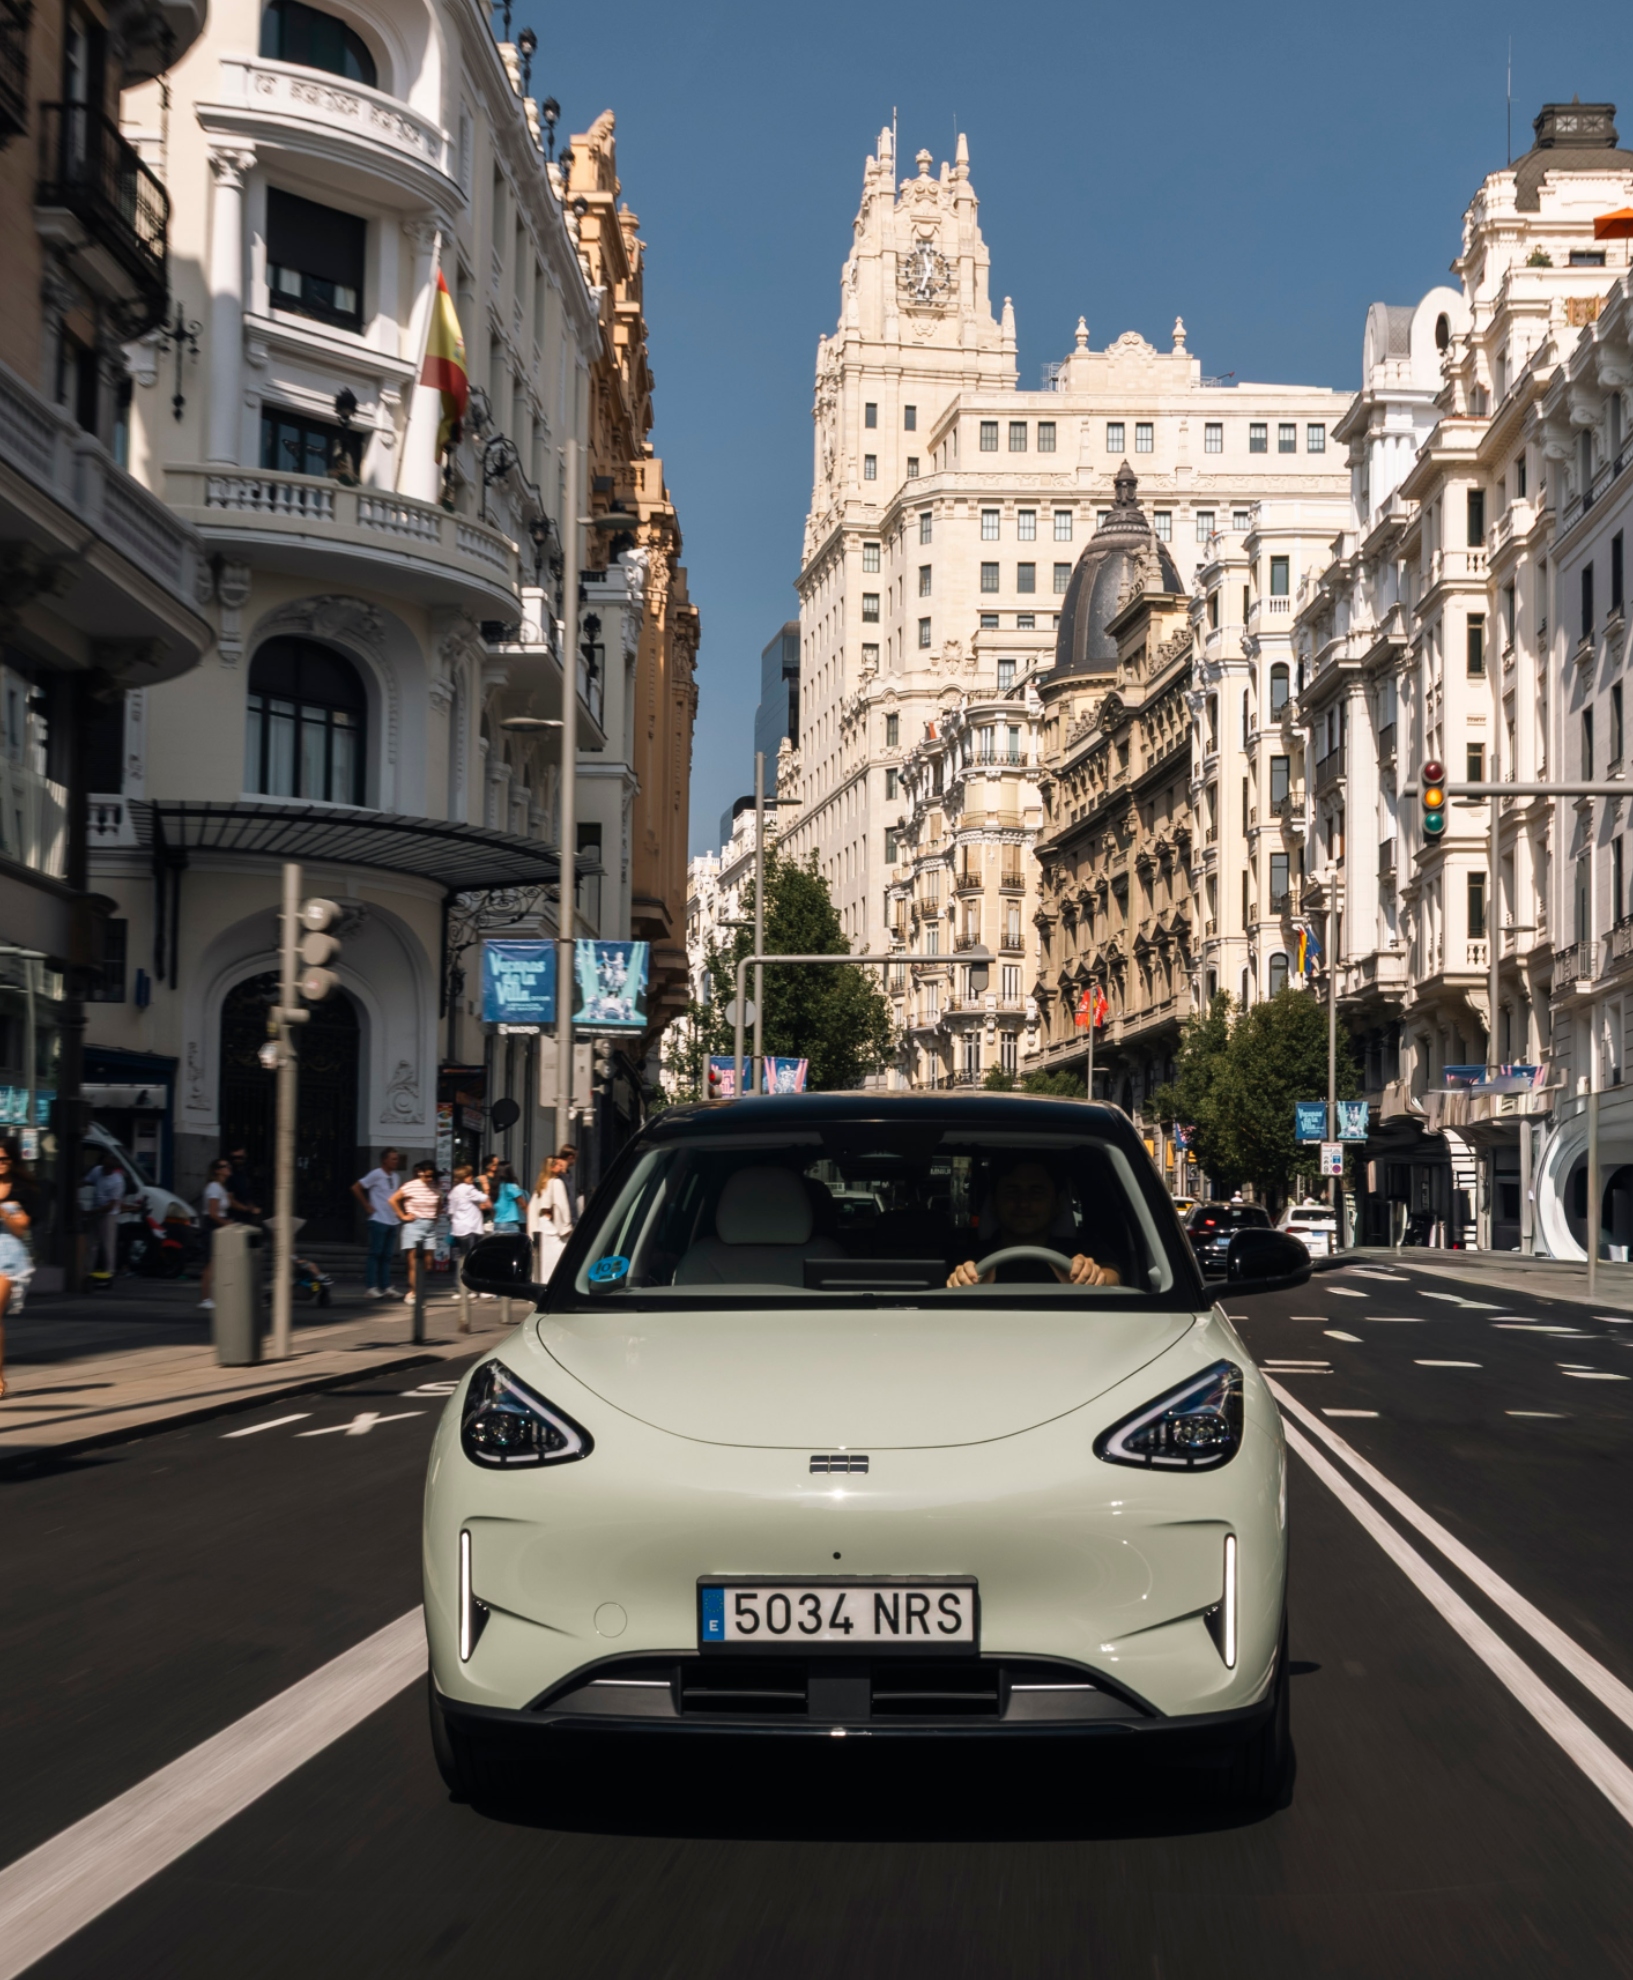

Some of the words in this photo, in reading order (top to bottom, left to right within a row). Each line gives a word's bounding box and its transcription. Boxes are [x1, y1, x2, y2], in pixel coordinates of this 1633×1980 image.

[495, 982, 530, 1005] Villa
[709, 1620, 719, 1632] E
[735, 1593, 854, 1635] 5034
[874, 1593, 962, 1635] NRS
